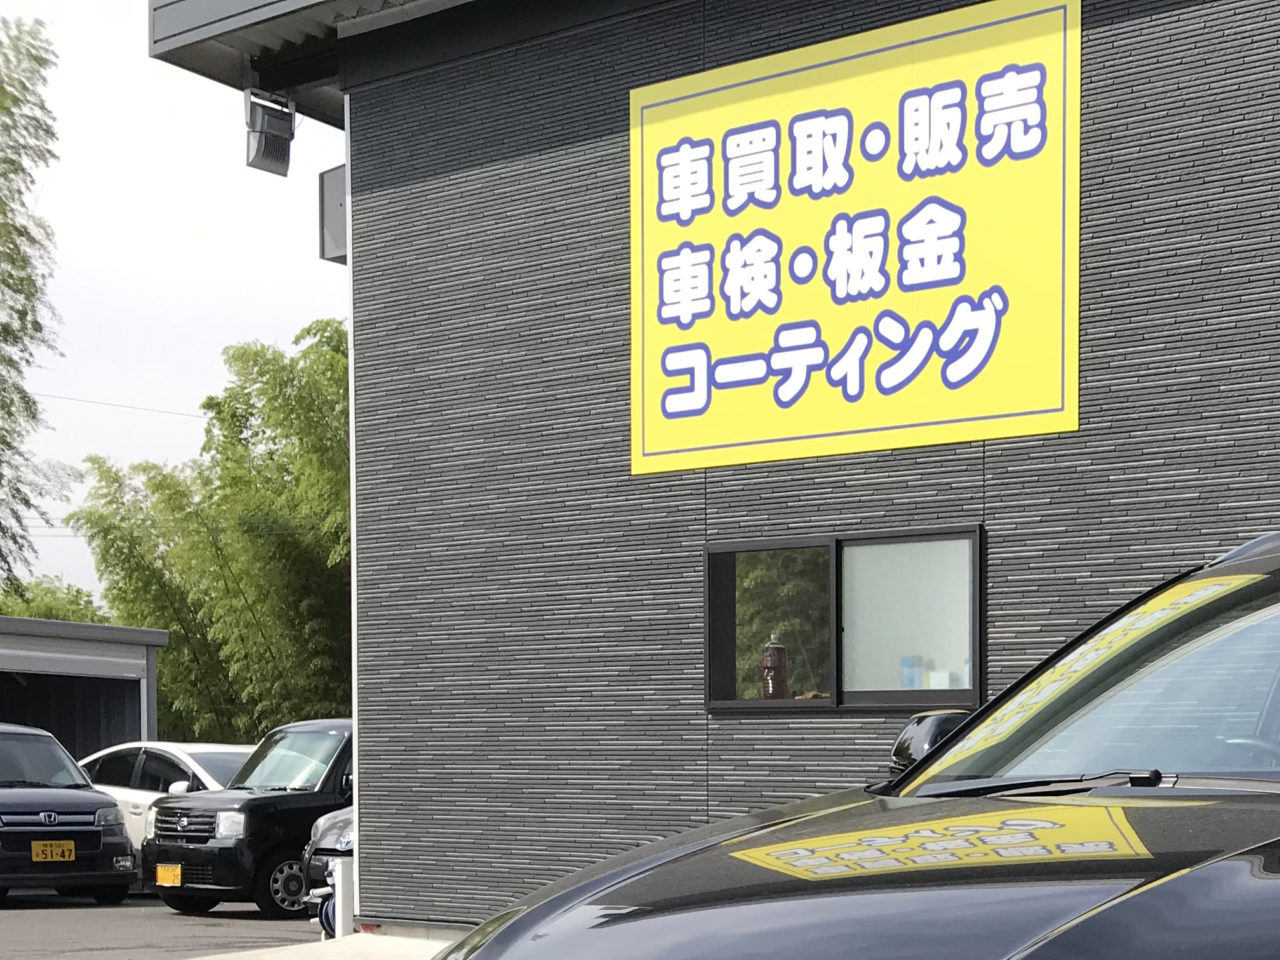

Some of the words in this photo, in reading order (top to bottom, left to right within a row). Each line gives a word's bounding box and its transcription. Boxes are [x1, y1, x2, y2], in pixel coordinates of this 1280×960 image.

[656, 63, 1047, 226] 車買取・販売
[656, 196, 966, 330] 車検・板金
[660, 285, 1009, 420] コーティング
